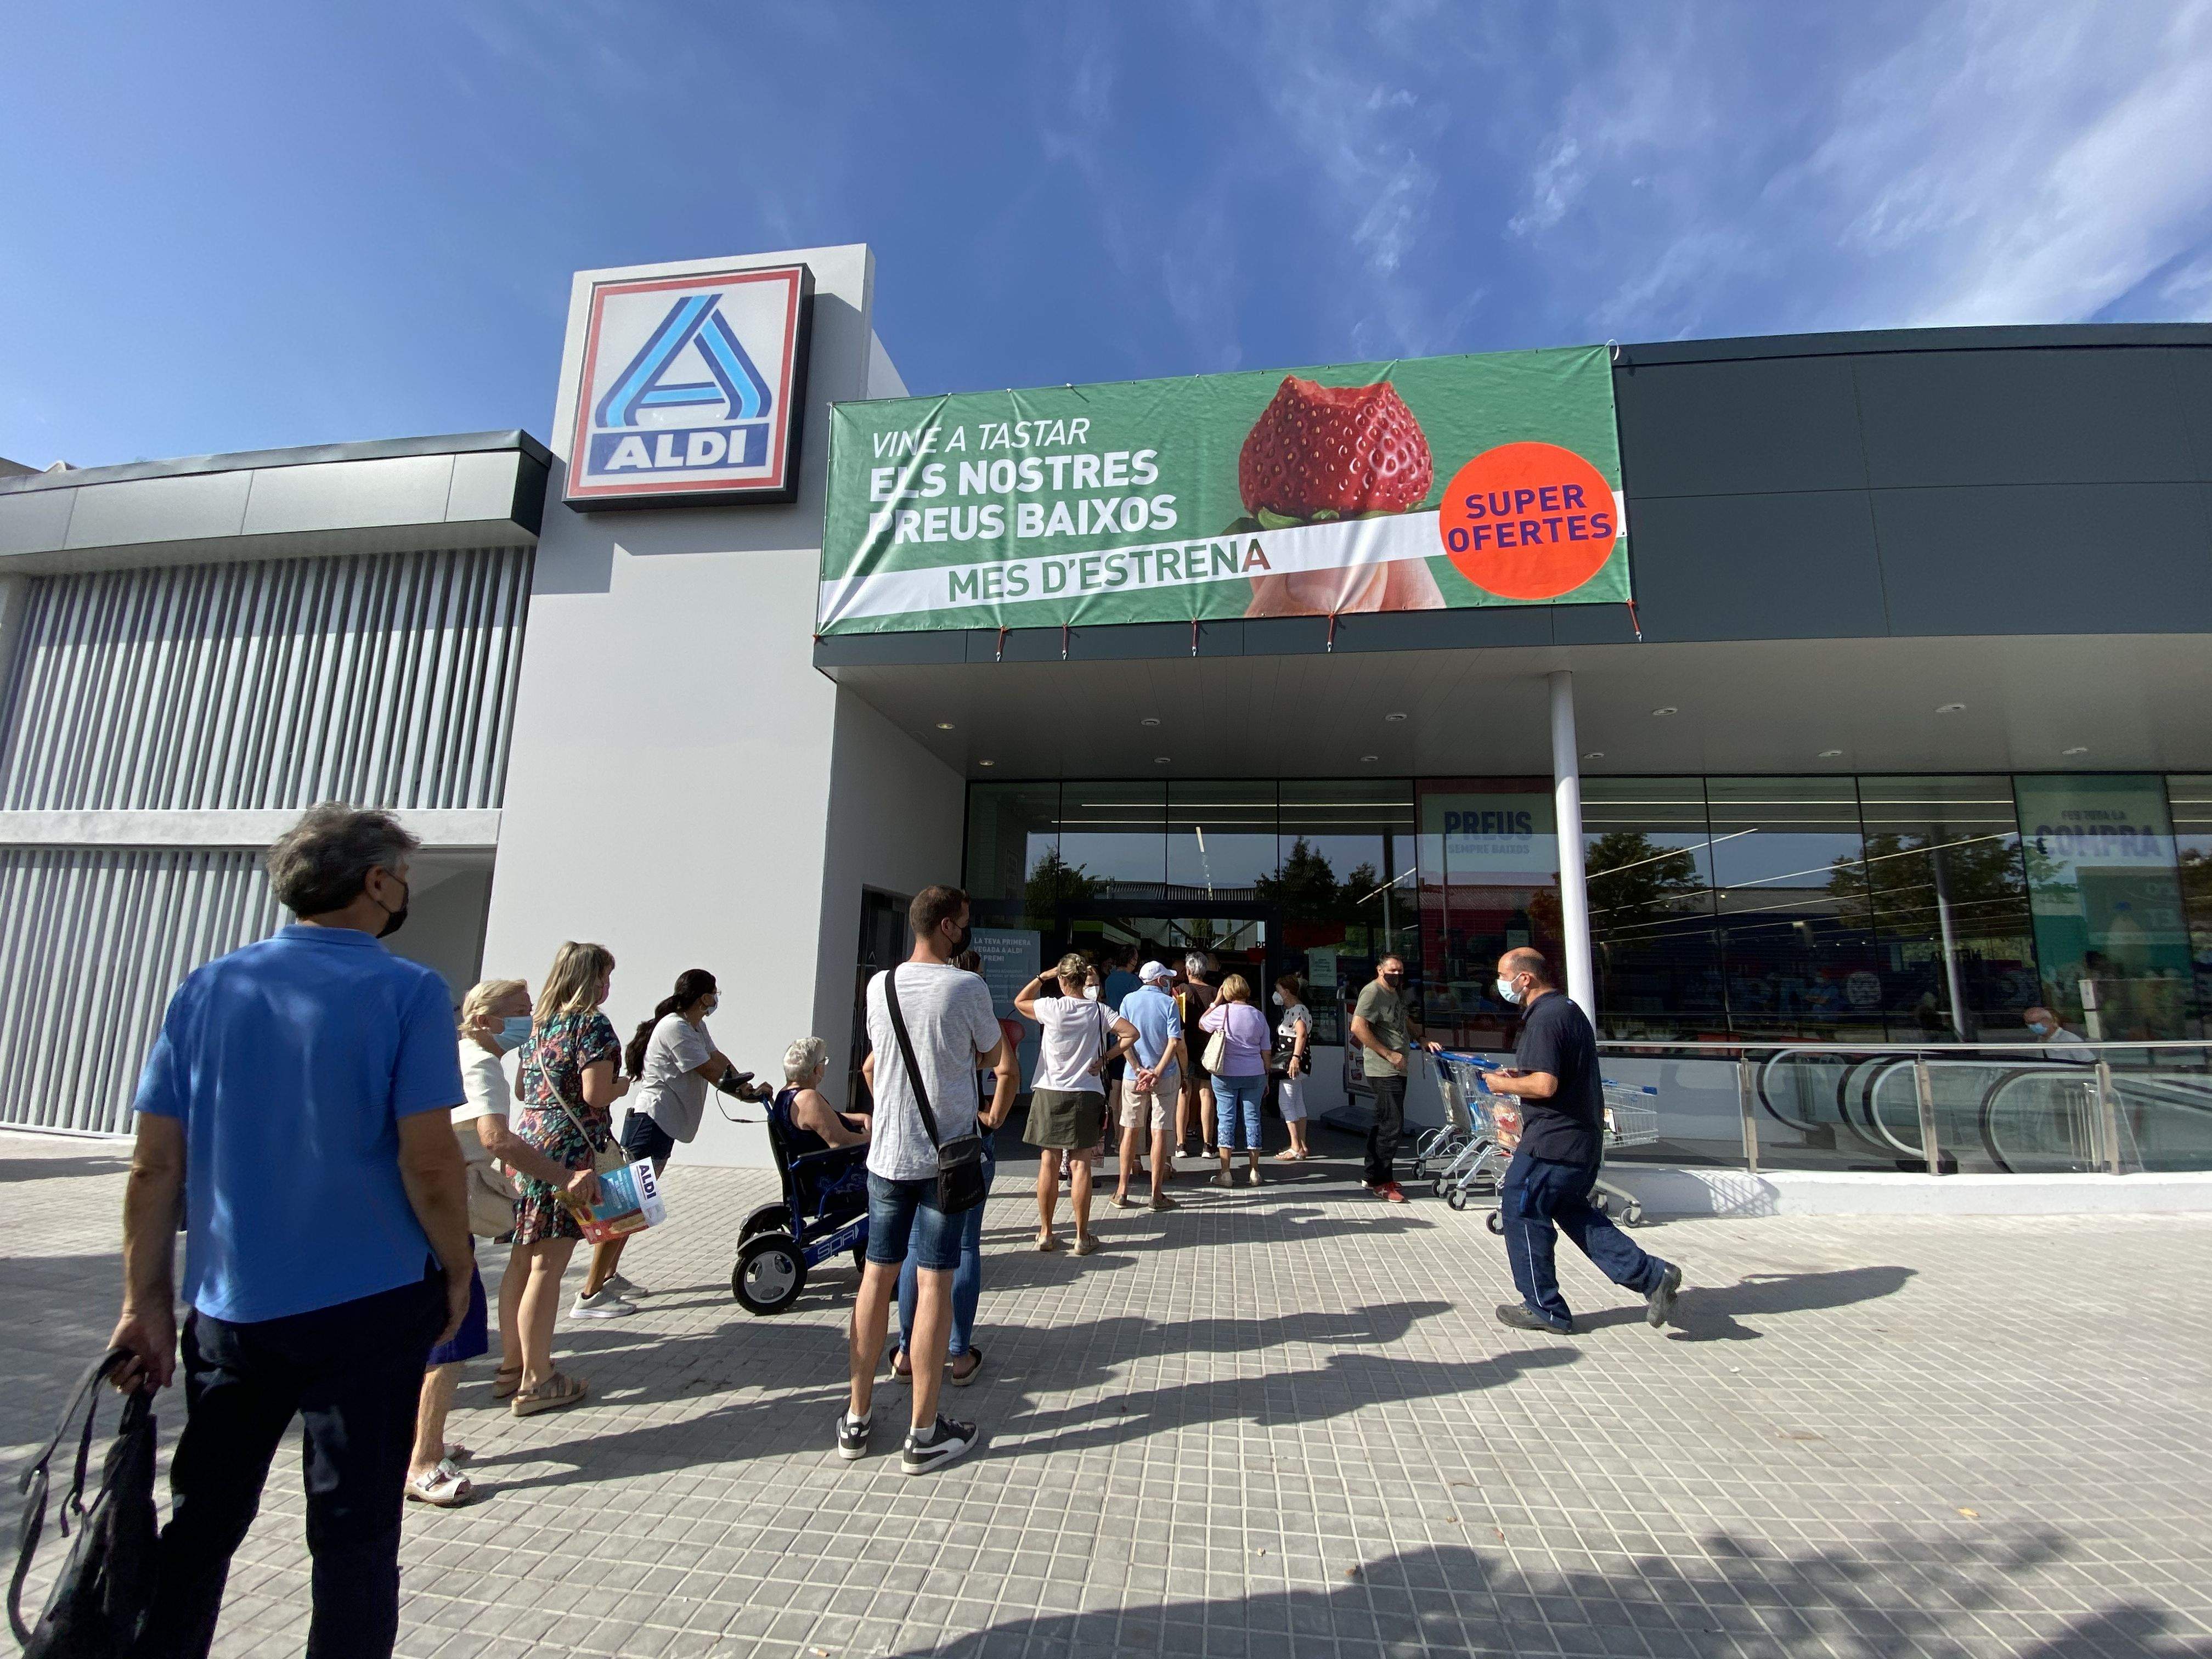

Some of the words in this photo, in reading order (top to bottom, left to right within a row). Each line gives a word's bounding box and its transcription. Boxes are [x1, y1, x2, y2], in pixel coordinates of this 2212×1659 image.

[604, 429, 747, 470] ALDI
[873, 426, 941, 459] VINE
[945, 425, 966, 453] A
[978, 417, 1091, 451] TASTAR
[870, 462, 947, 503] ELS
[958, 449, 1159, 496] NOSTRES
[868, 504, 1005, 545] PREUS
[1017, 494, 1177, 538] BAIXOS
[1465, 484, 1588, 519] SUPER
[1448, 513, 1612, 552] OFERTES
[949, 564, 1030, 602] MES
[1042, 538, 1272, 594] D'ESTRENA
[1444, 811, 1533, 840] PREUS
[2035, 825, 2162, 857] COMPRA
[1448, 844, 1489, 854] SEMPRE
[1492, 844, 1530, 854] BAIXOS
[639, 1165, 657, 1199] ALDI
